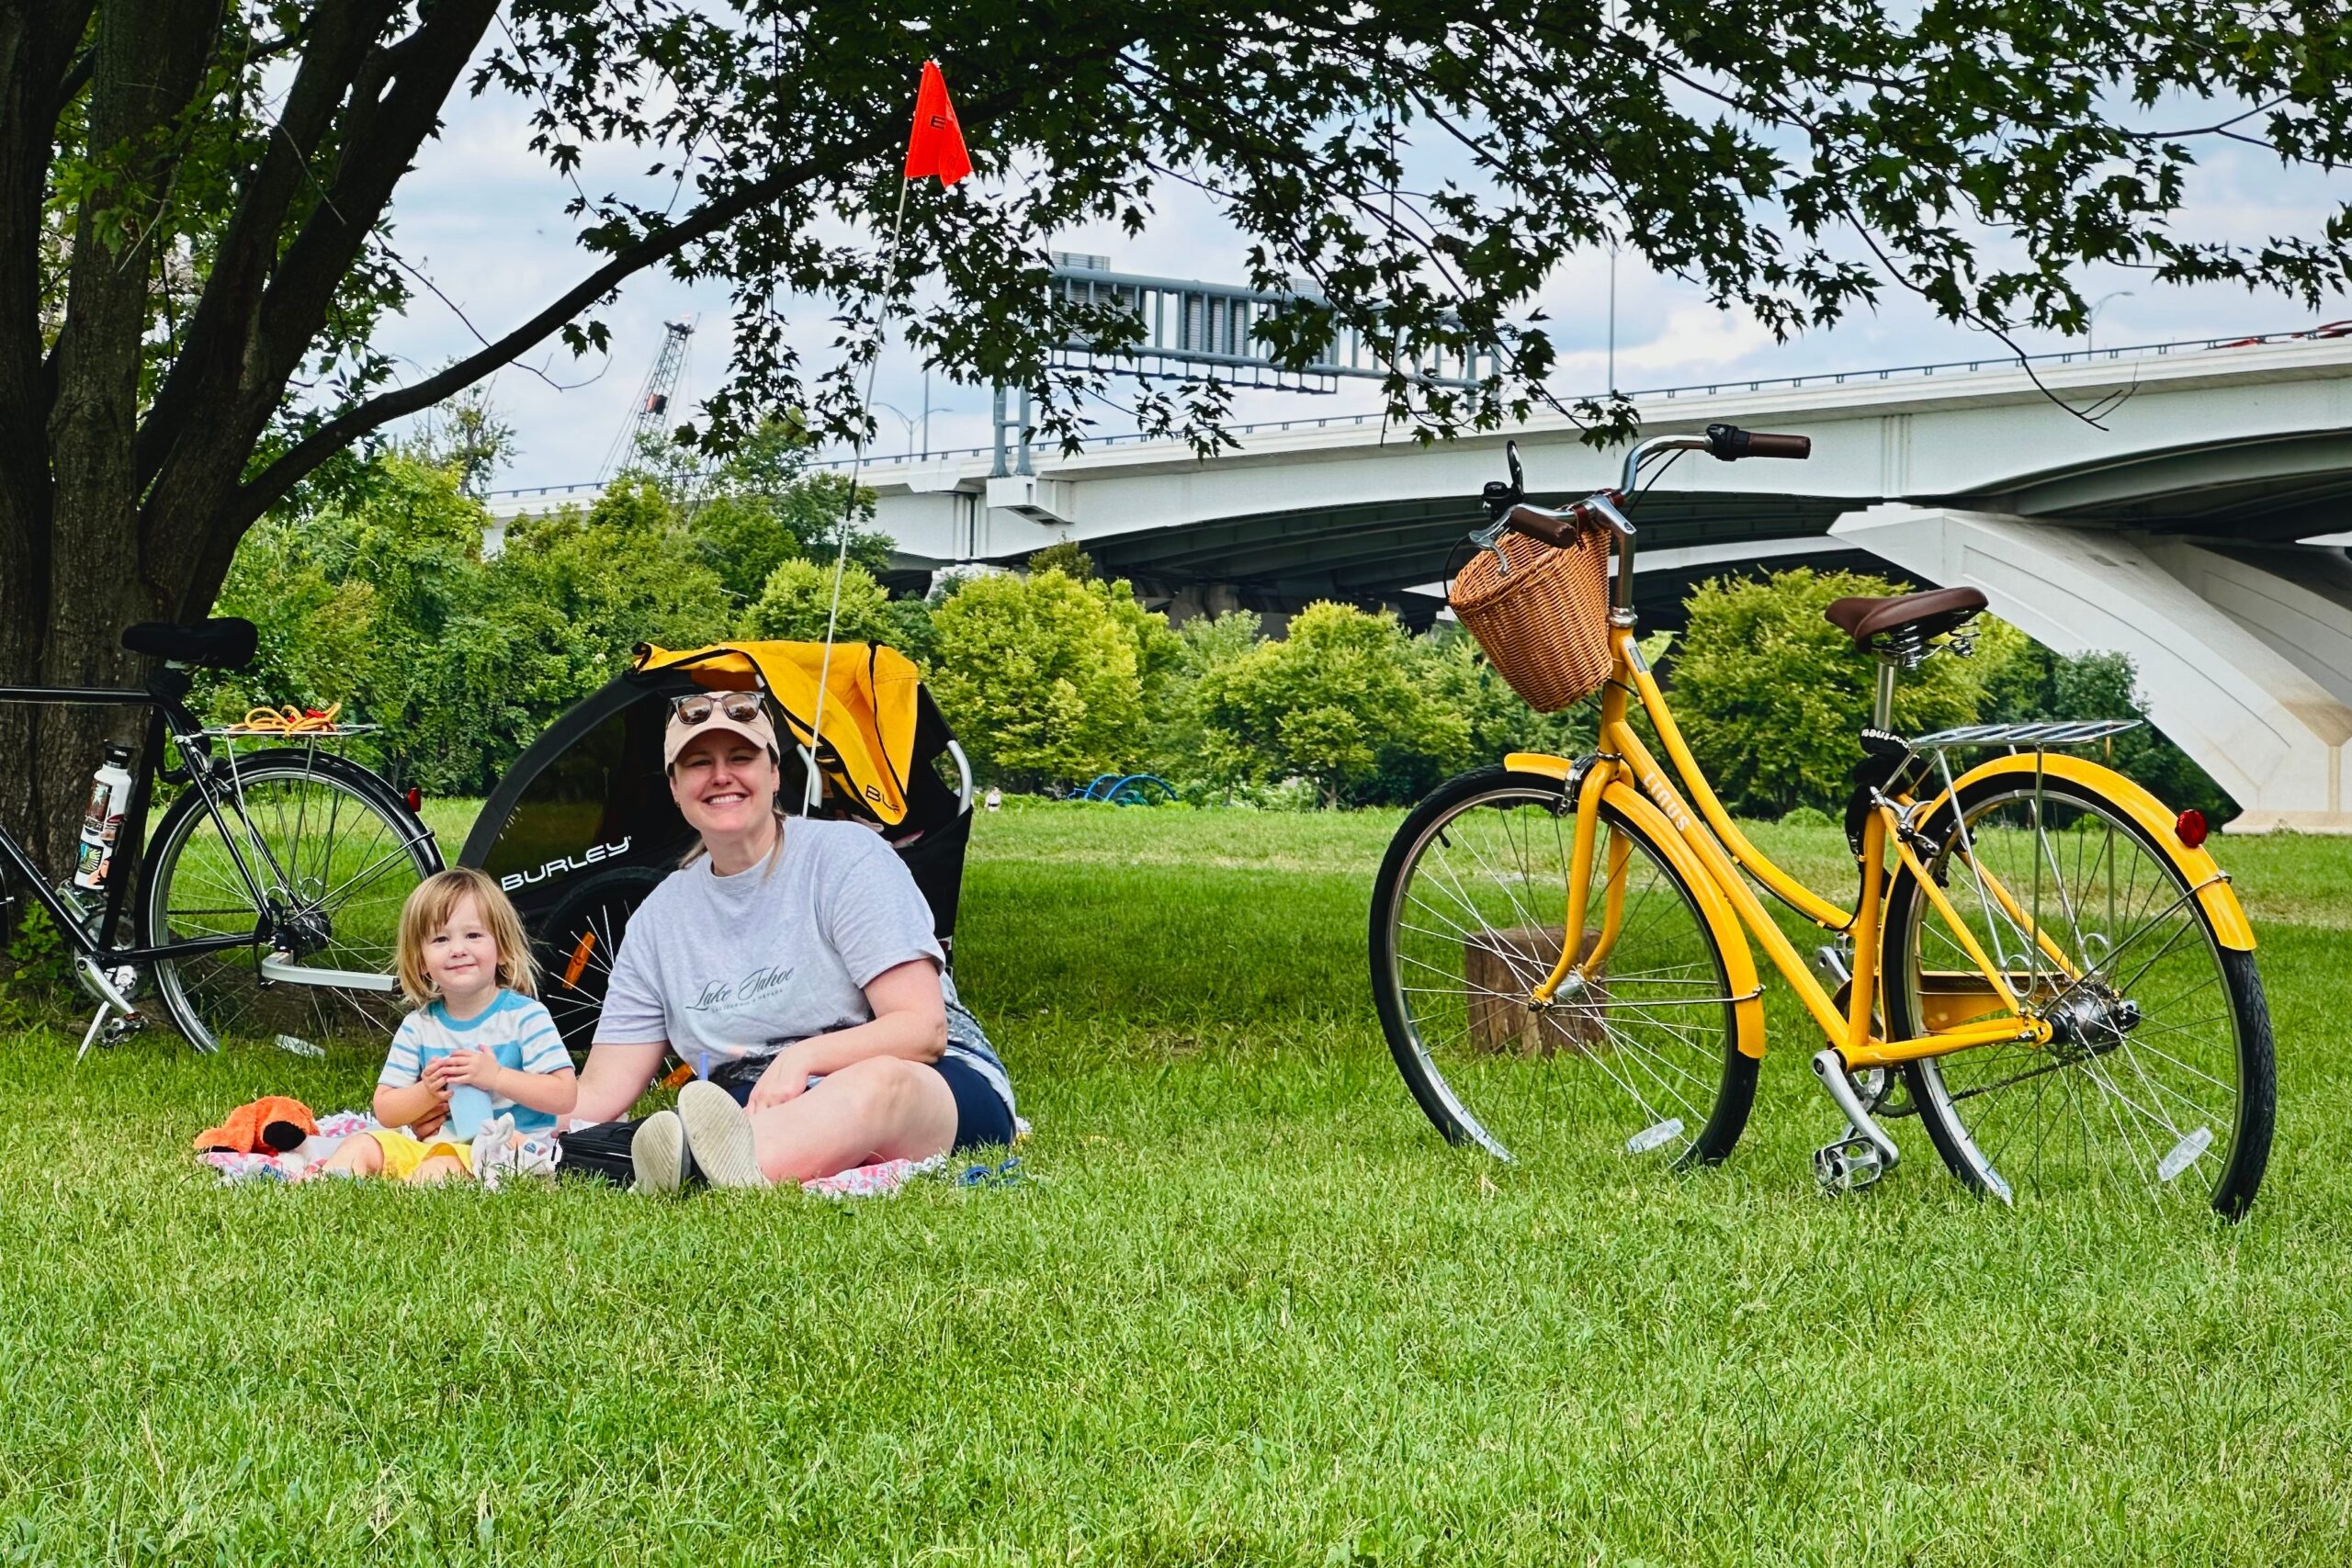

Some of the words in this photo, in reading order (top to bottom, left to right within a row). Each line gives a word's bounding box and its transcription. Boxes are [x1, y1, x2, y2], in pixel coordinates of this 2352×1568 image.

[501, 836, 631, 892] BURLEY
[685, 980, 732, 1010] Lake
[738, 965, 794, 1000] Tahoe
